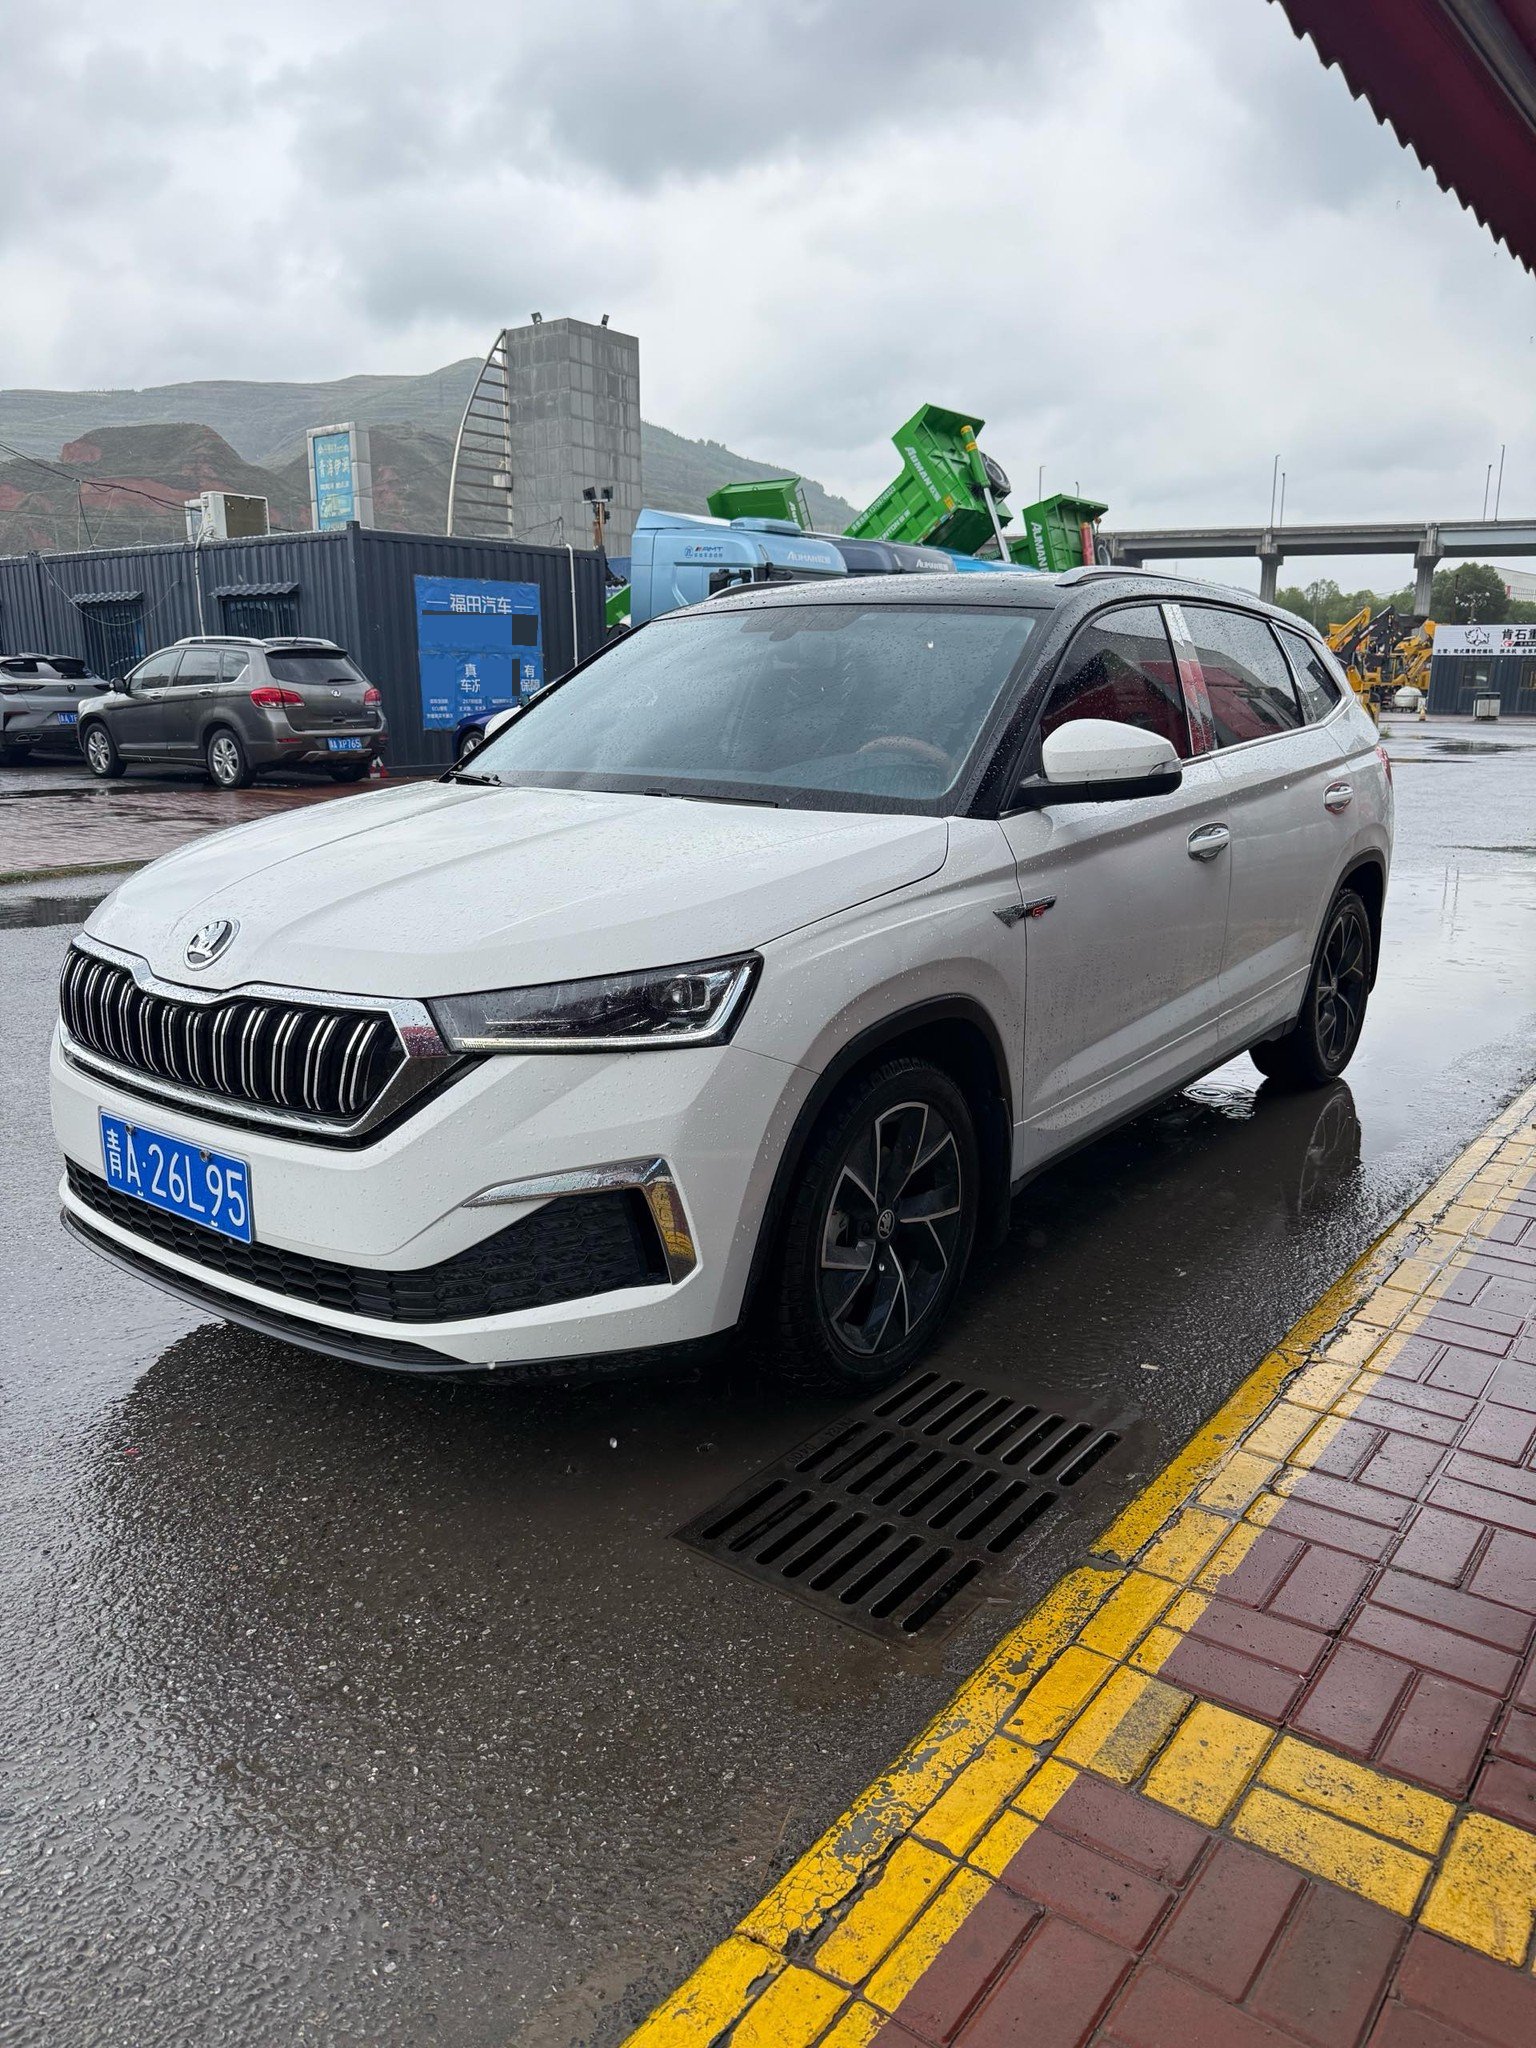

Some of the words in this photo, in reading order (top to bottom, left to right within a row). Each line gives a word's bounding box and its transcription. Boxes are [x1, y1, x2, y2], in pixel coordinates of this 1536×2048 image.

[450, 593, 513, 615] 福田汽车
[464, 663, 477, 678] 真
[524, 664, 535, 678] 有
